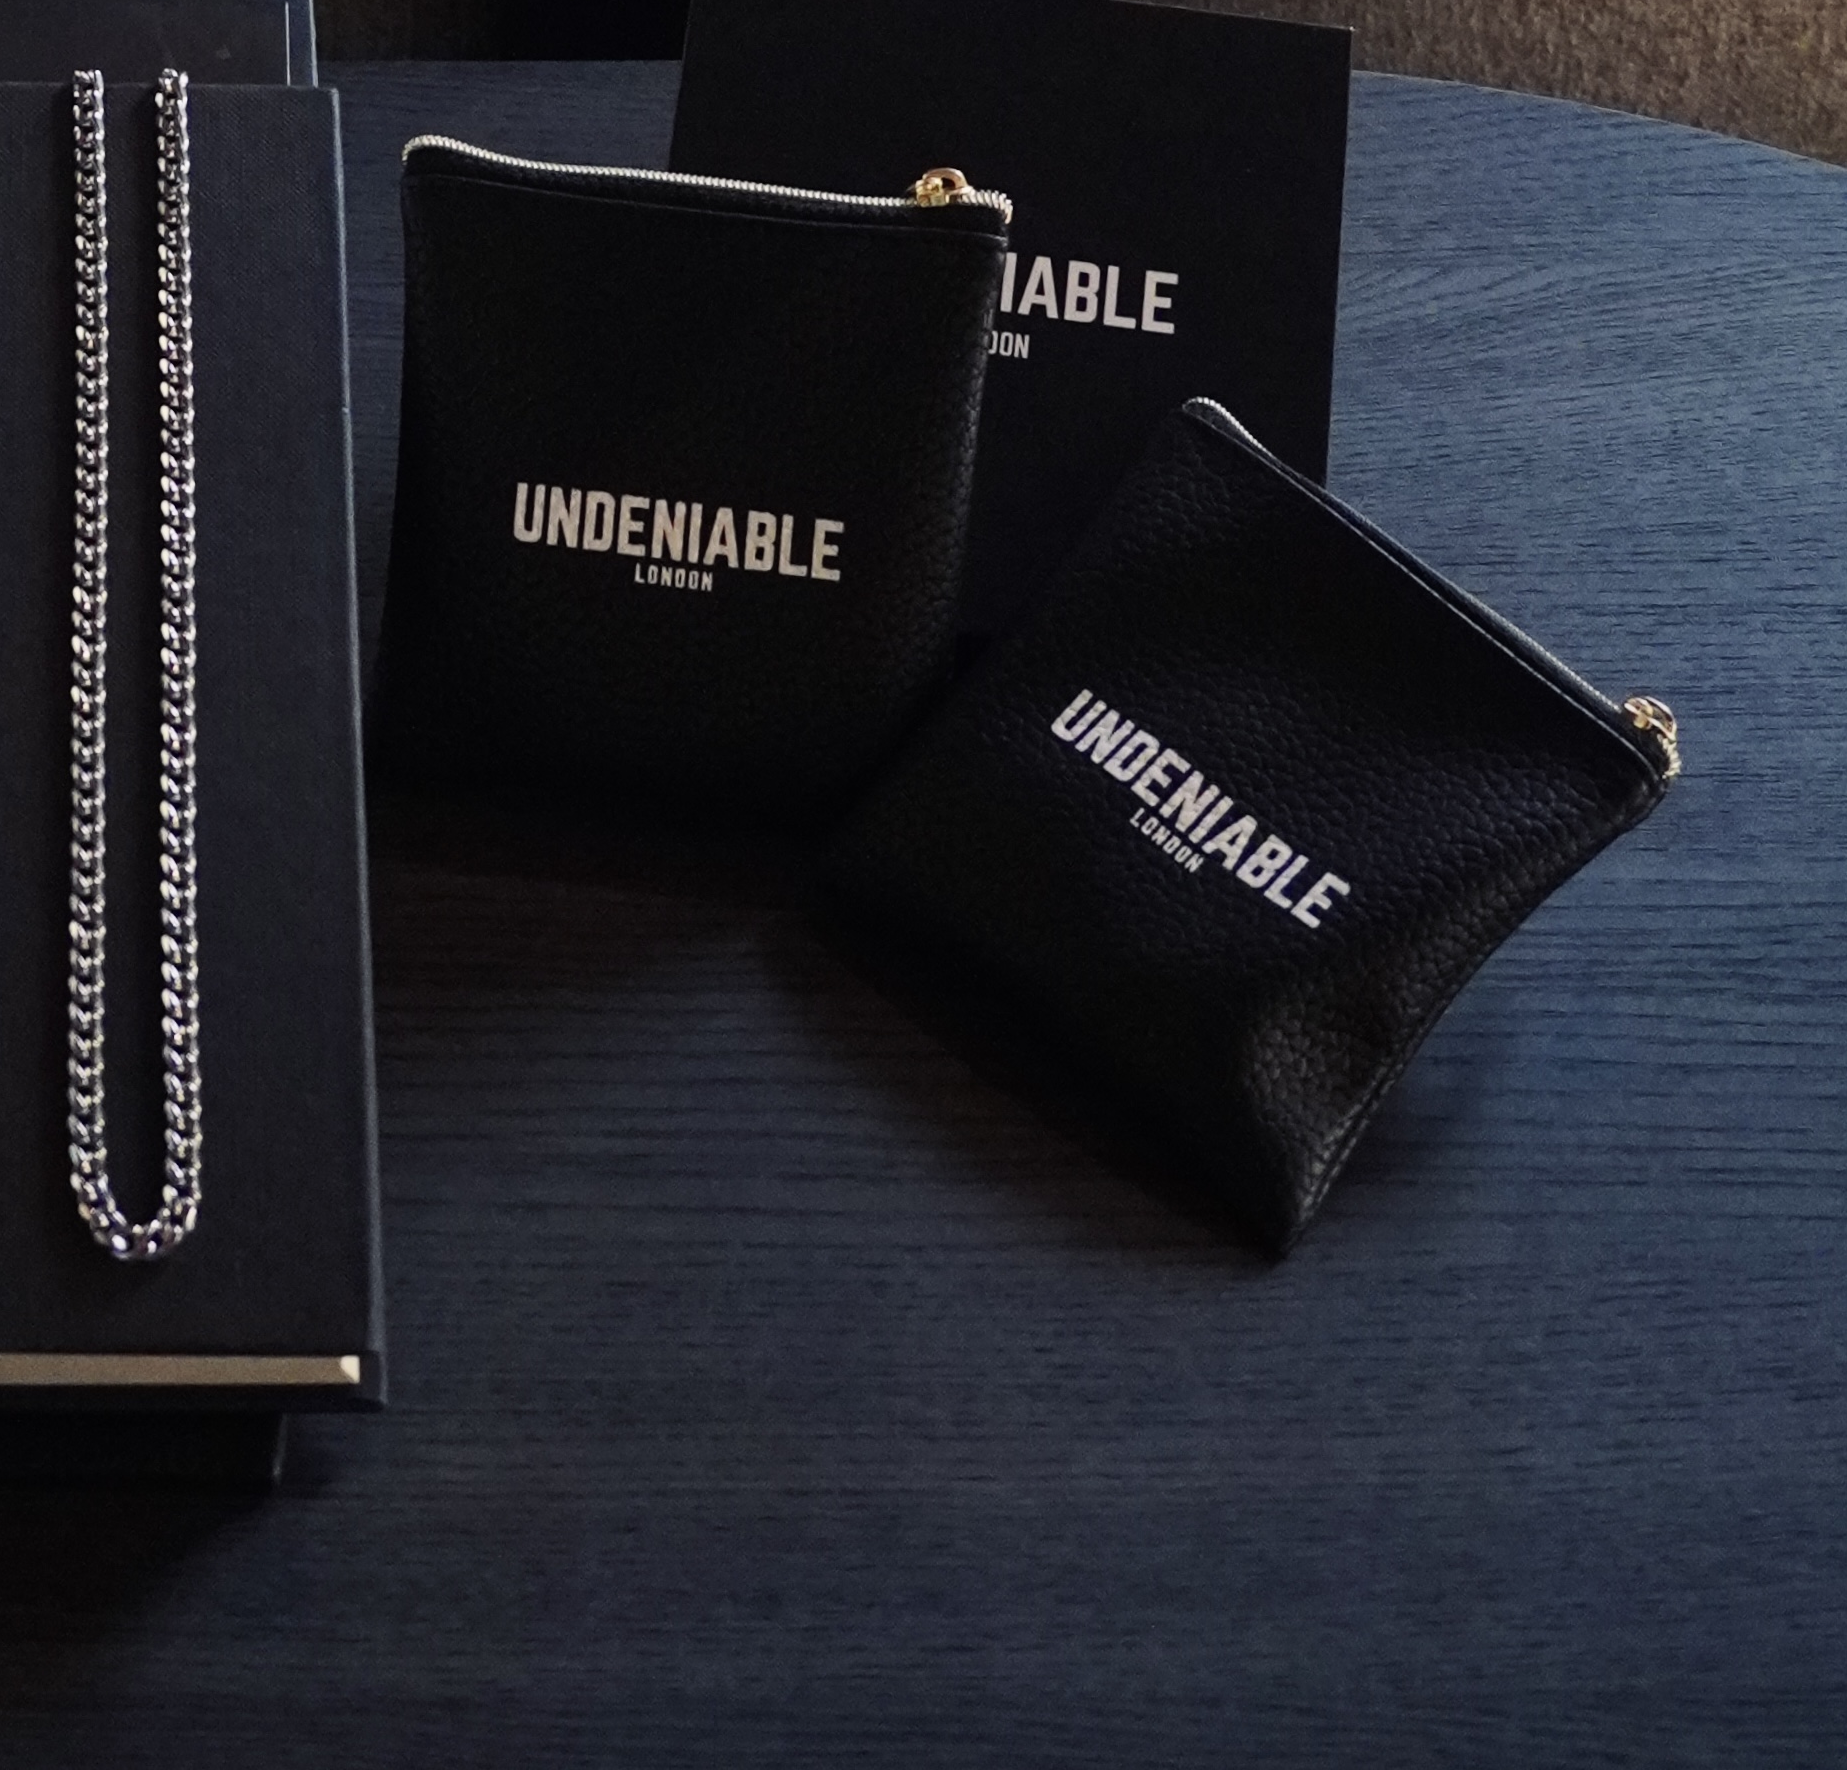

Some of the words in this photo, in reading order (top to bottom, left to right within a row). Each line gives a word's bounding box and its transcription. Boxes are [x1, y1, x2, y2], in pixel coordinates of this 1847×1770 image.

[999, 250, 1180, 336] IABLE
[512, 481, 845, 583] UNDENIABLE
[633, 562, 714, 593] LONDON
[1049, 687, 1352, 930] UNDENIABLE
[1128, 806, 1205, 874] LONDON
